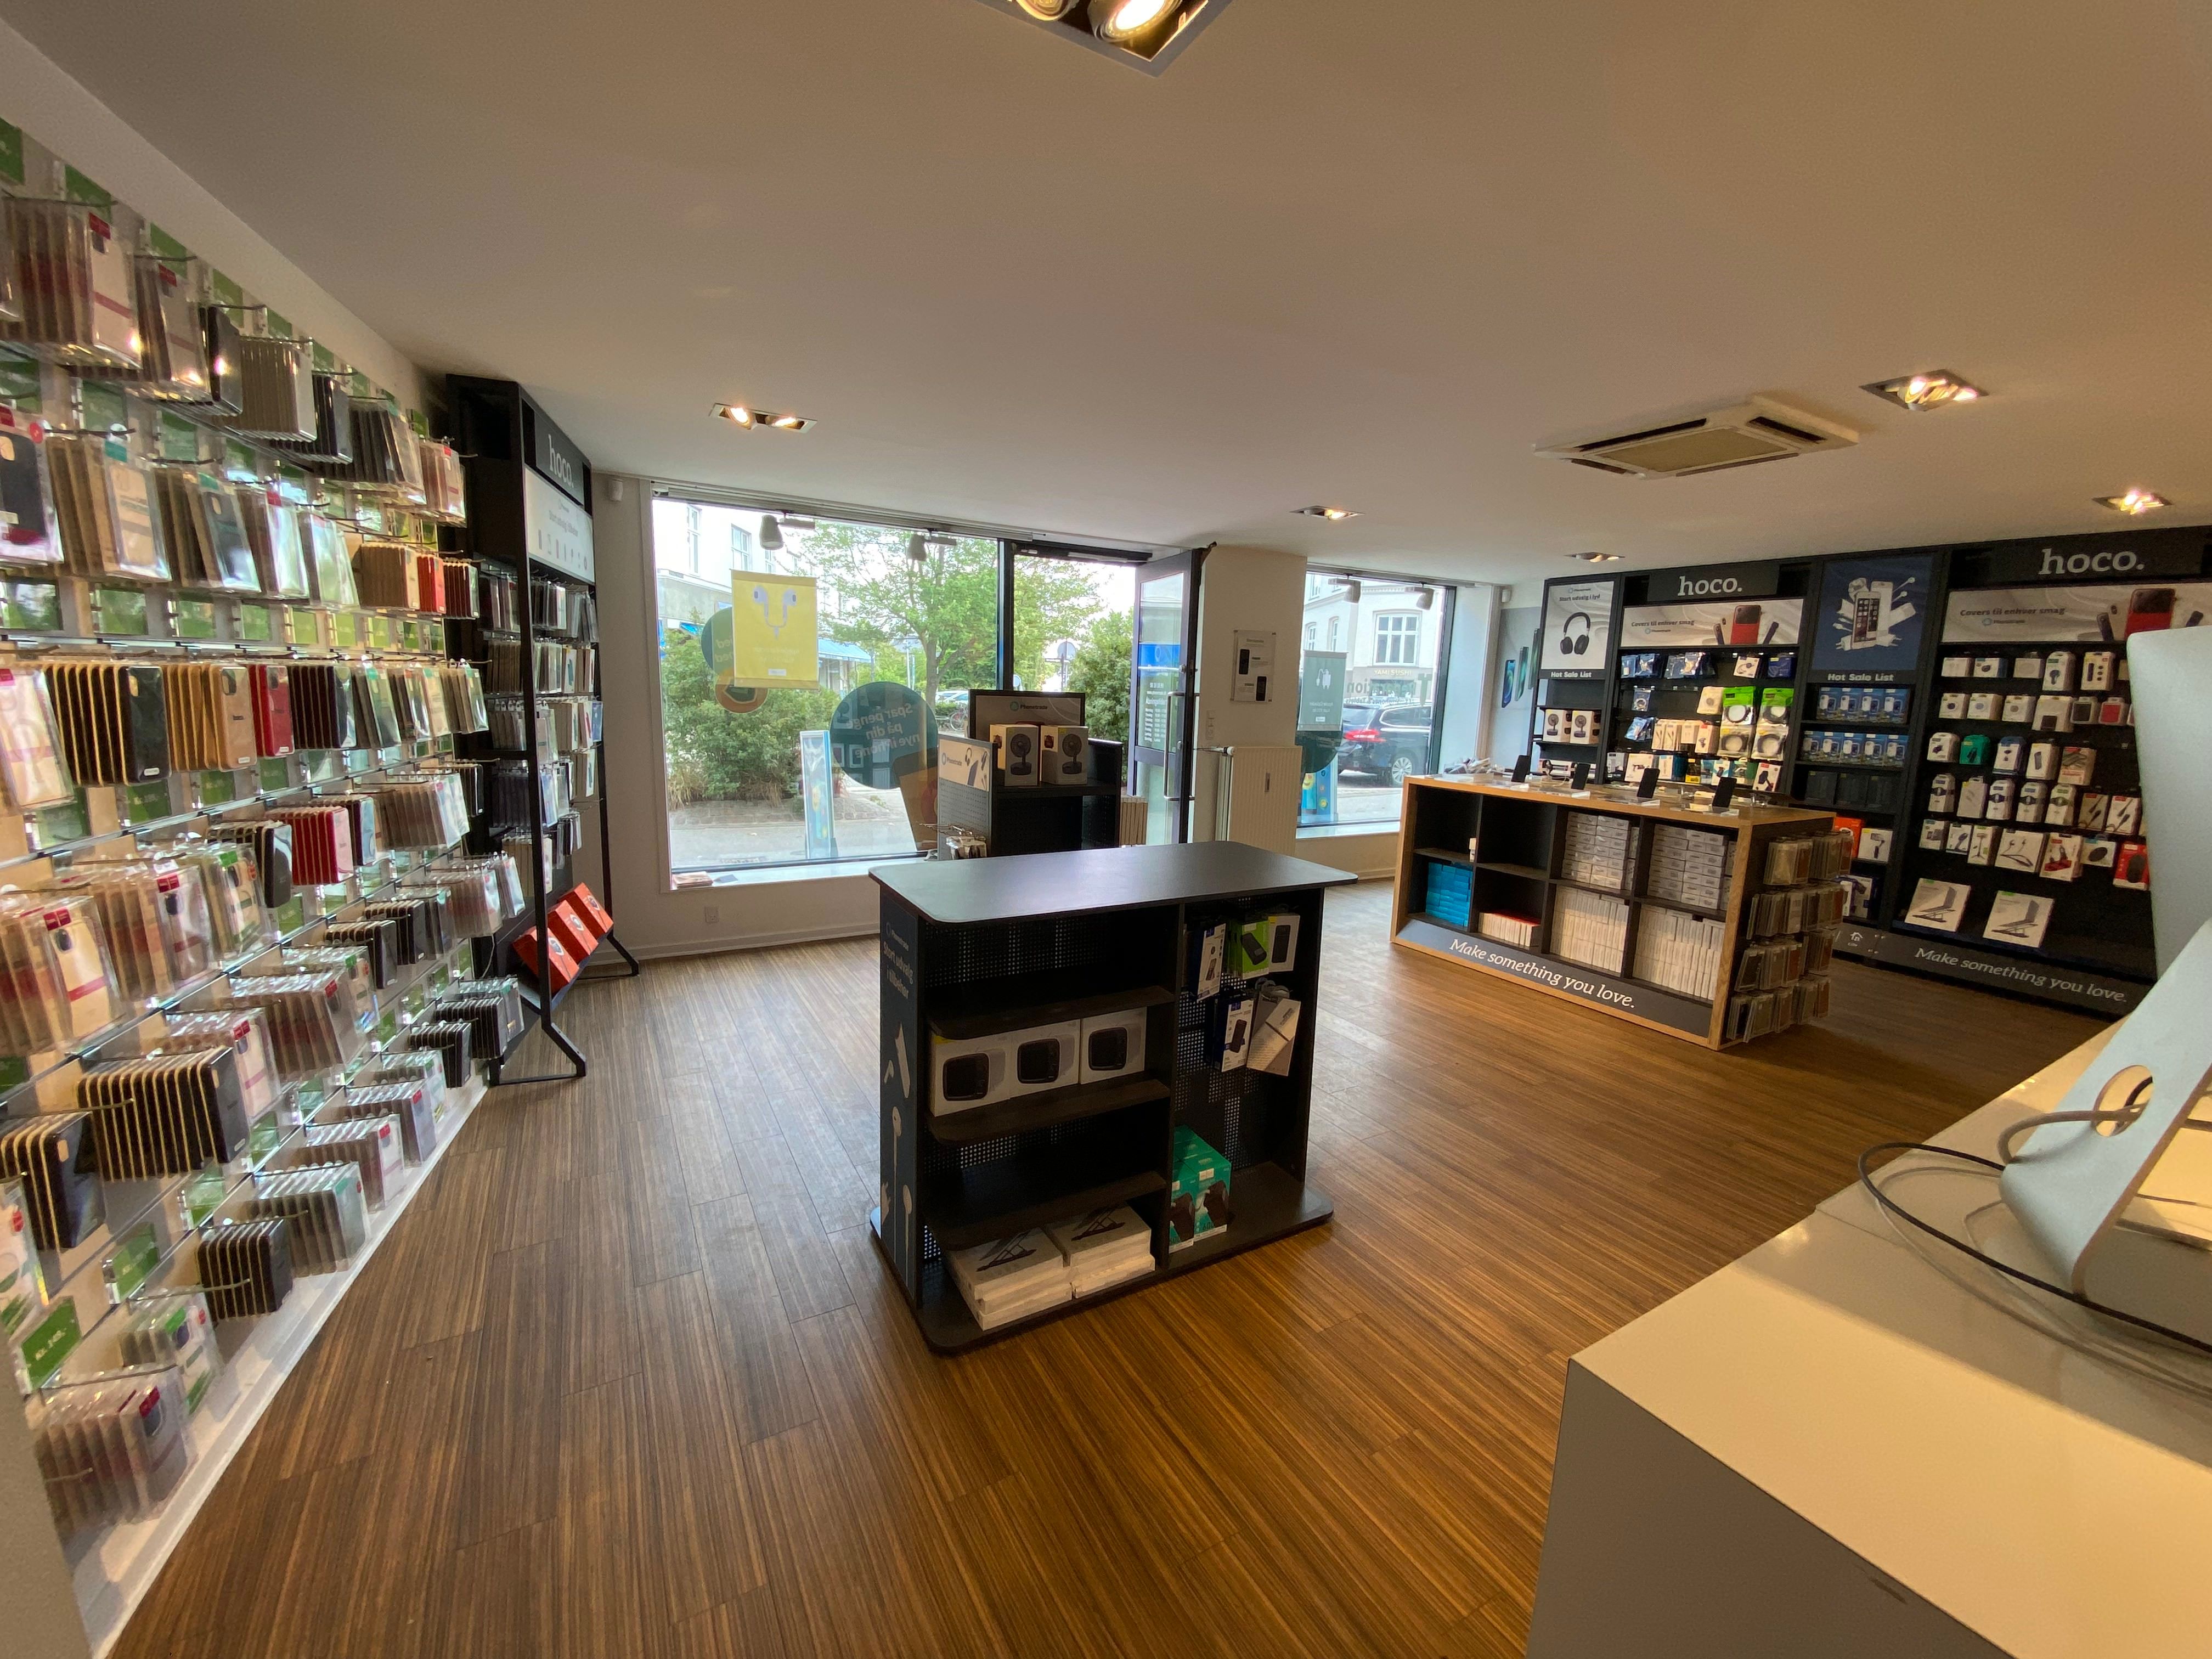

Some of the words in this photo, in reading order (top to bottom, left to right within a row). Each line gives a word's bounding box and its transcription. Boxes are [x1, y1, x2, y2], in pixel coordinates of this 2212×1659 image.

[549, 434, 574, 488] hoco.
[2038, 548, 2145, 574] hoco.
[1678, 575, 1742, 596] hoco.
[1875, 673, 1895, 681] List
[1449, 939, 1487, 960] Make
[1487, 953, 1563, 986] something
[1564, 976, 1594, 996] you
[1596, 984, 1635, 1008] love.
[1915, 947, 1959, 967] Make
[1960, 958, 2047, 986] something
[2050, 978, 2083, 994] you
[2086, 983, 2128, 1003] love.
